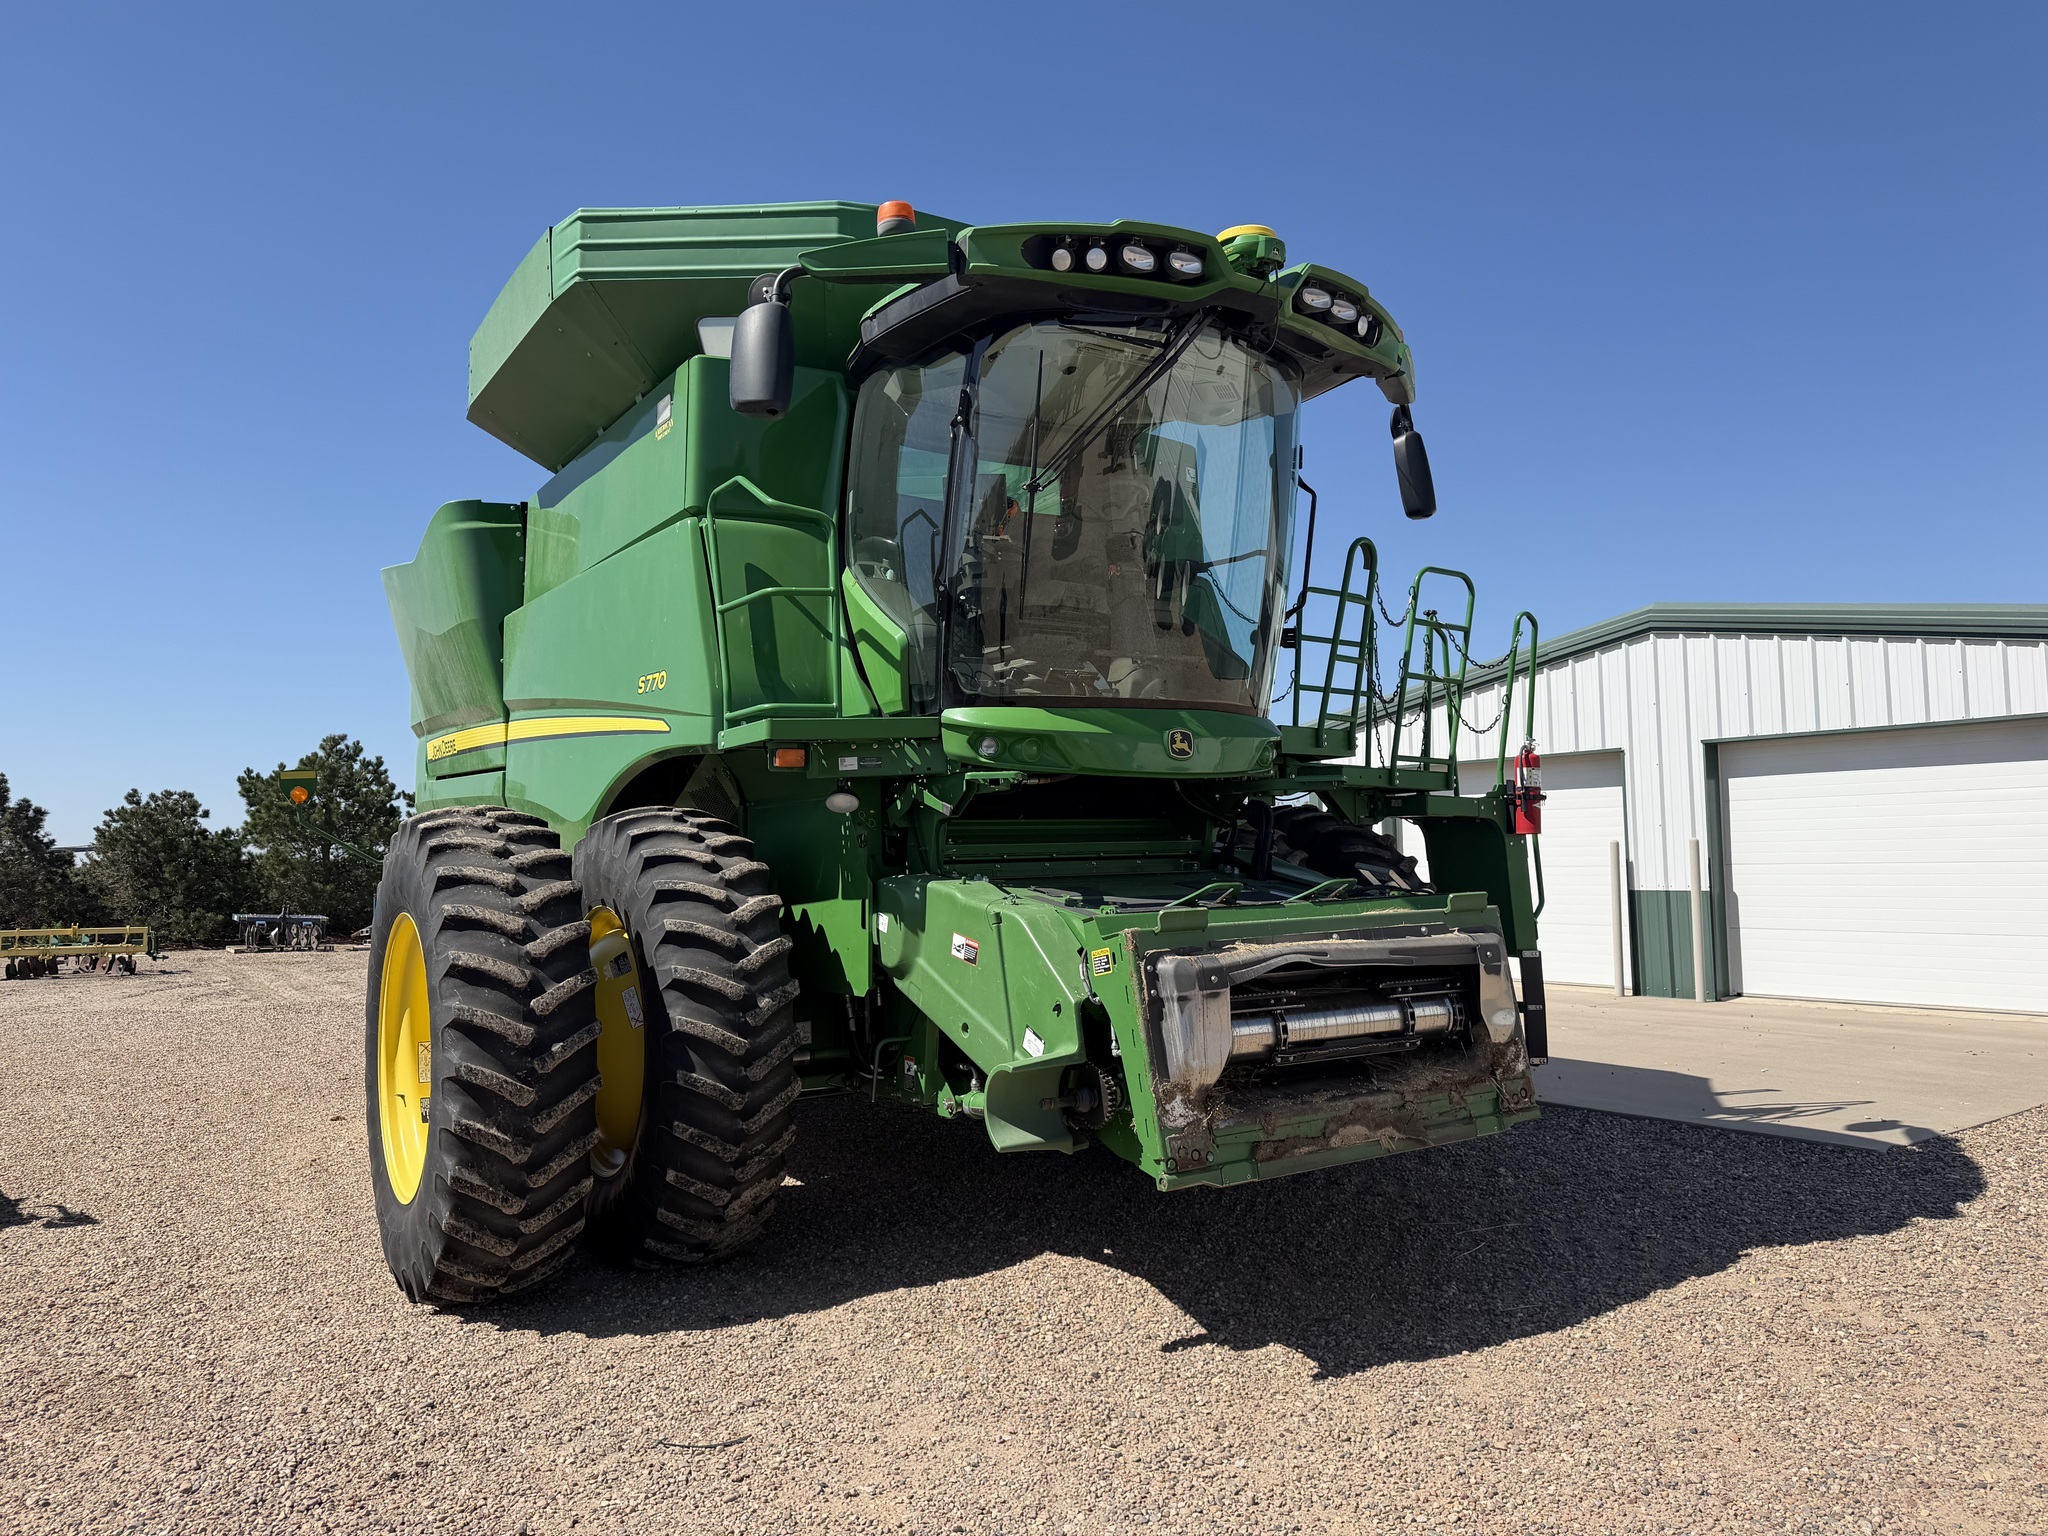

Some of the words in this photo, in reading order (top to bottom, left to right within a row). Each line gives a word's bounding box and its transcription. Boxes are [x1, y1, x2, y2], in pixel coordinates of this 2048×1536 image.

[637, 670, 667, 695] S770
[432, 744, 443, 758] JOHN
[442, 739, 457, 755] DEERE
